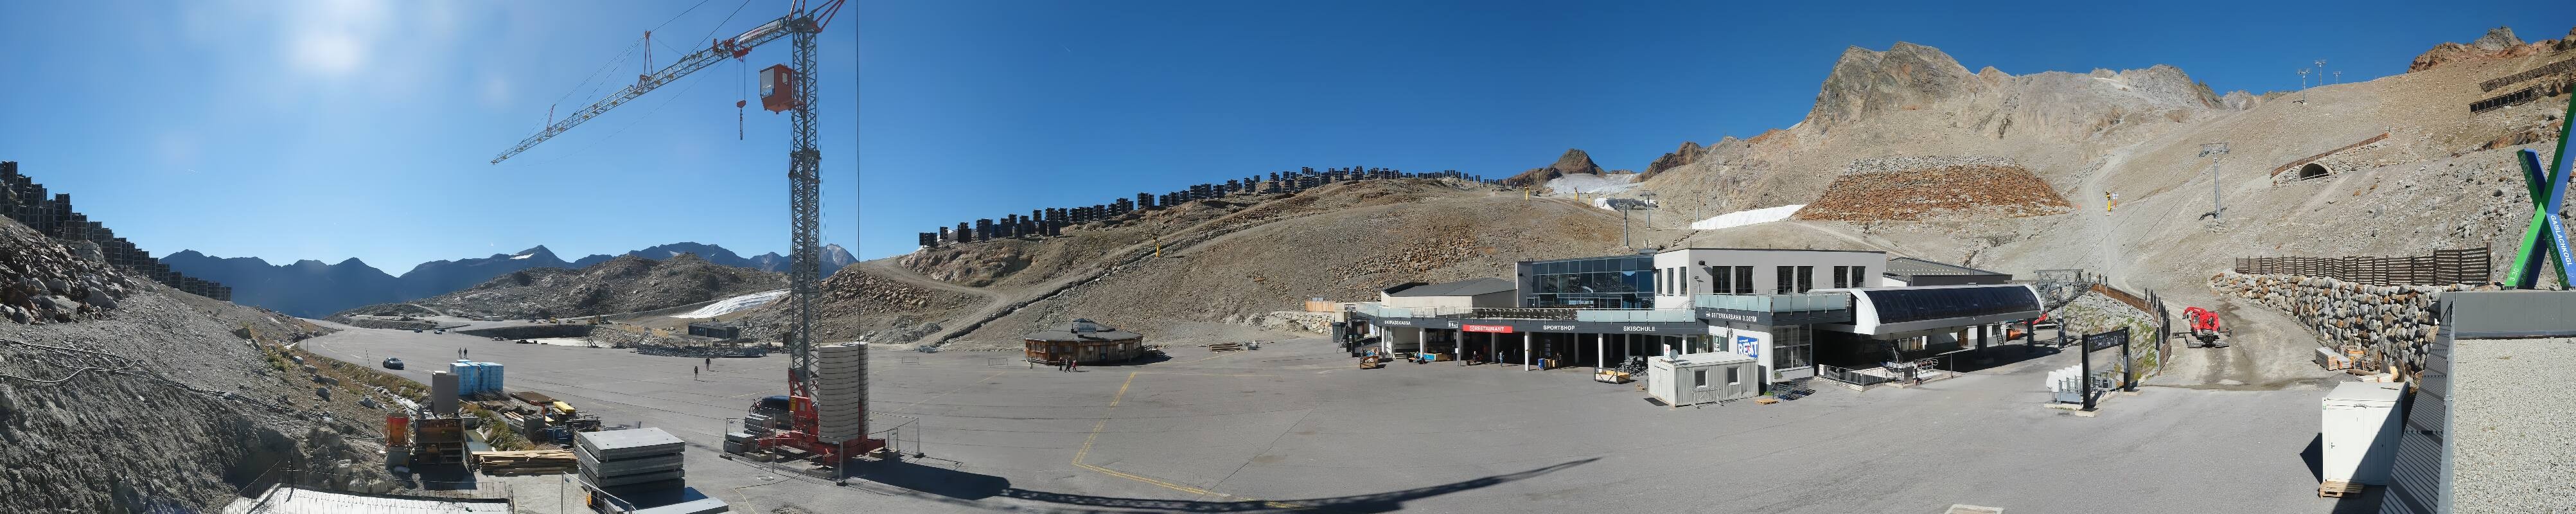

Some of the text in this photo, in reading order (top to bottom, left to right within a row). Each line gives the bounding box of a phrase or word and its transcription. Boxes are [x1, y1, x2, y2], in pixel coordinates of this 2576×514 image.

[2520, 154, 2533, 184] BIG 3
[2550, 215, 2573, 267] GAISLACHKOGL
[1738, 341, 1758, 357] RENT
